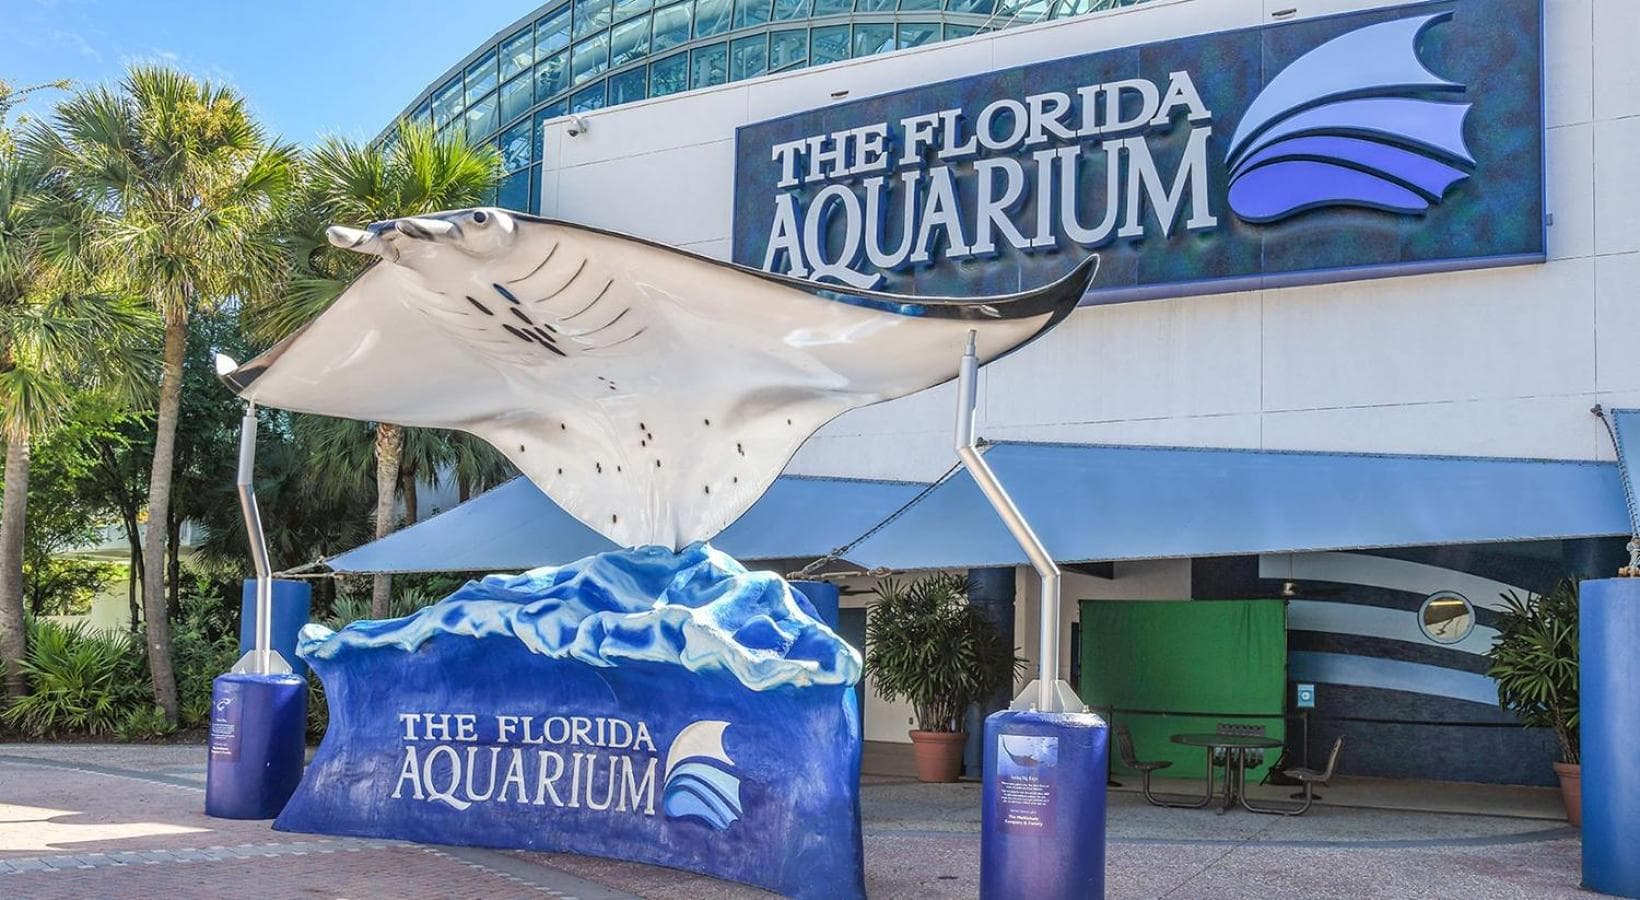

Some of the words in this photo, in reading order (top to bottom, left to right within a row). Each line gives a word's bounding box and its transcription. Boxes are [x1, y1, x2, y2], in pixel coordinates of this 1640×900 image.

[772, 126, 887, 188] THE
[899, 70, 1212, 165] FLORIDA
[762, 126, 1217, 290] AQUARIUM
[400, 713, 478, 741] THE
[496, 715, 657, 752] FLORIDA
[391, 745, 658, 815] AQUARIUM
